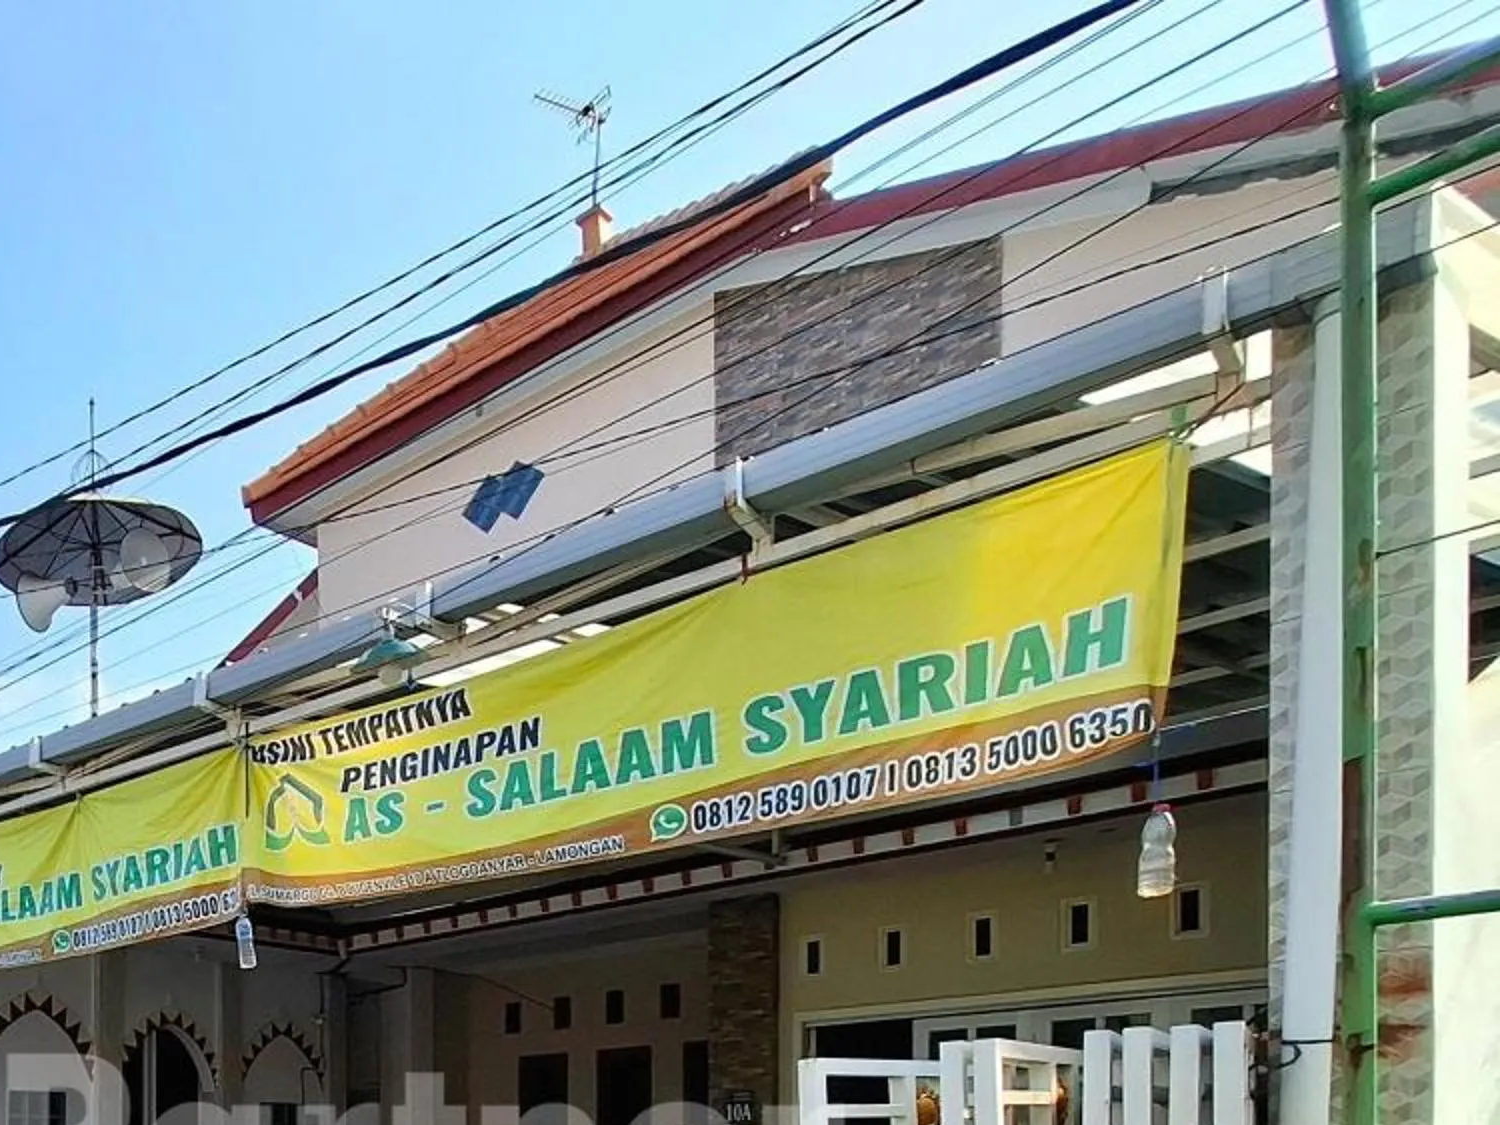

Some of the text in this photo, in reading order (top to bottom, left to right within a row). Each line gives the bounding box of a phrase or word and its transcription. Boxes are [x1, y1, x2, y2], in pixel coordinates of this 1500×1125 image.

[317, 688, 472, 753] TEMPATNYA
[340, 717, 542, 793] PENGINAPAN
[343, 794, 405, 842] AS
[466, 711, 715, 818] SALAAM
[743, 597, 1128, 756] SYARIAH
[692, 795, 752, 832] 0812
[759, 783, 804, 822] 589
[813, 769, 878, 808] 0107
[906, 746, 976, 788] 0813
[988, 725, 1059, 770] 5000
[1070, 703, 1152, 748] 6350
[92, 824, 238, 900] SYARIAH
[537, 836, 624, 865] LAMONGAN
